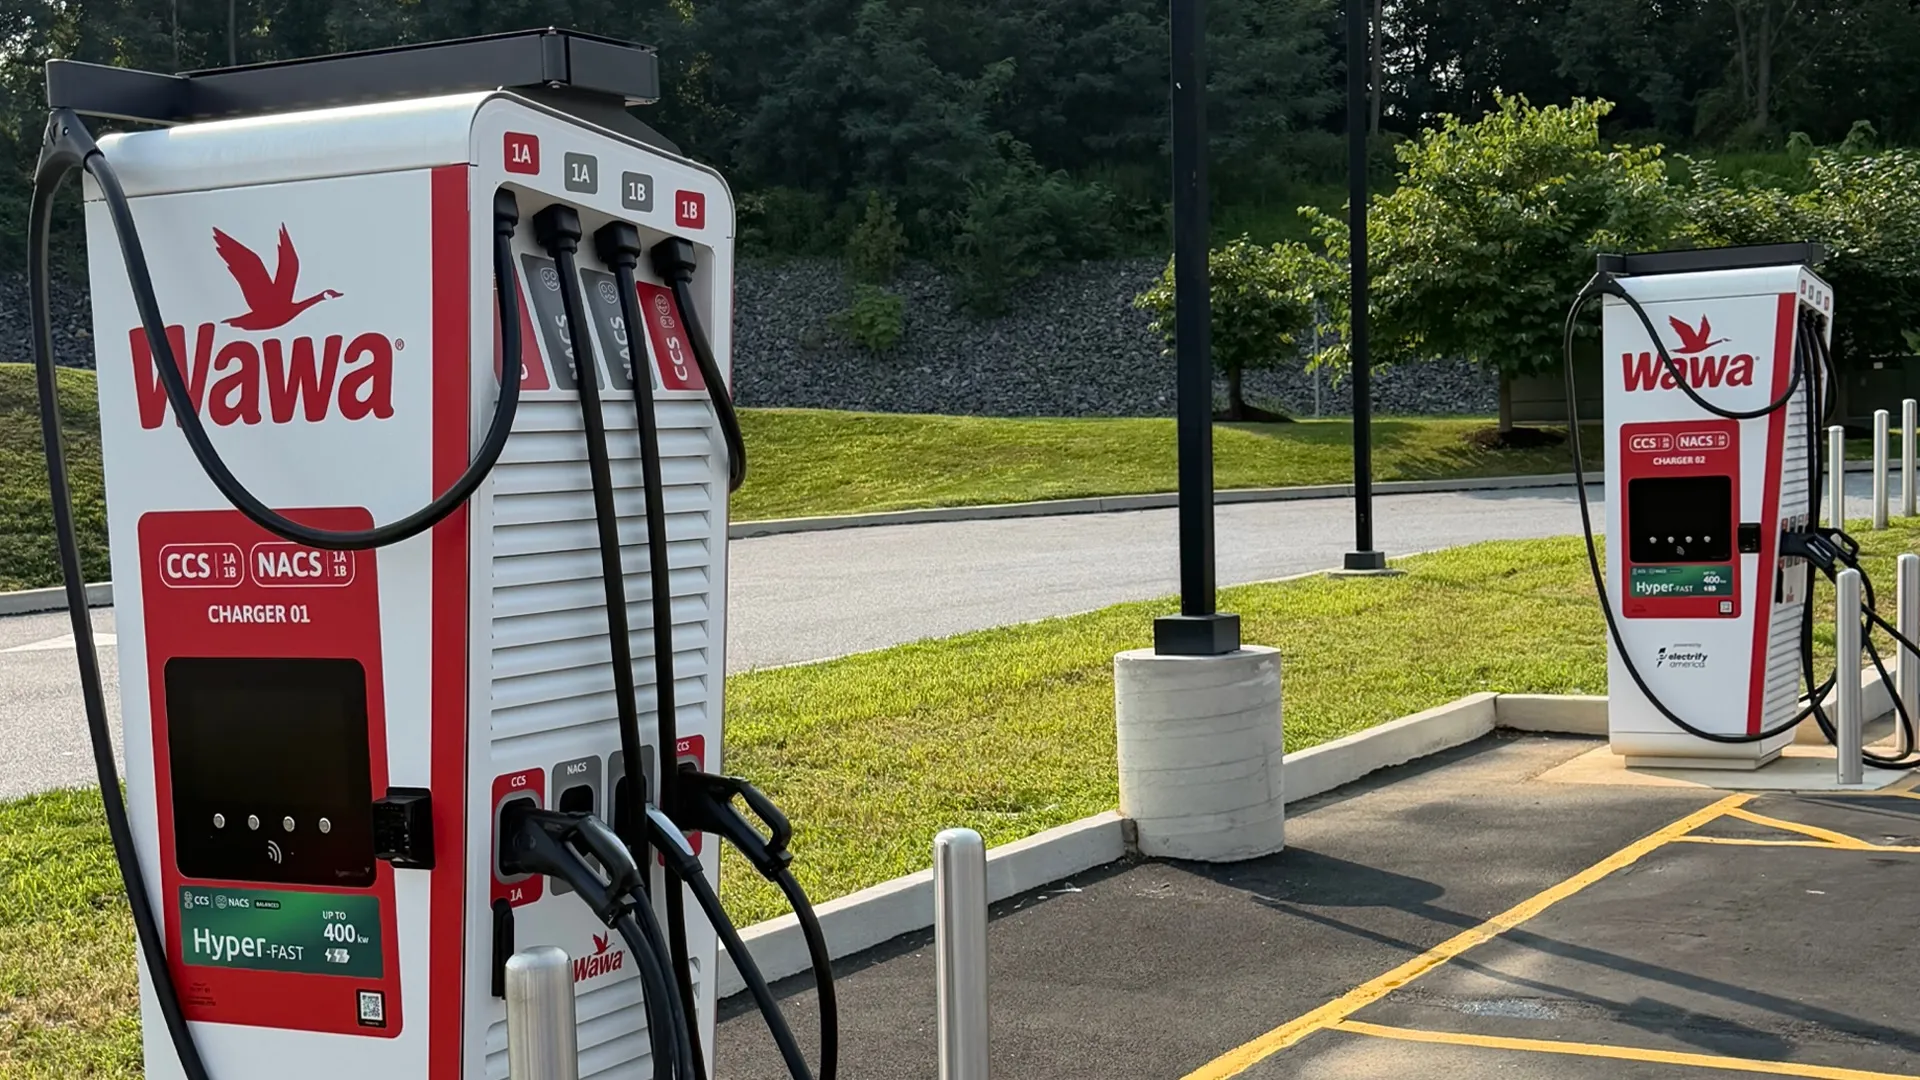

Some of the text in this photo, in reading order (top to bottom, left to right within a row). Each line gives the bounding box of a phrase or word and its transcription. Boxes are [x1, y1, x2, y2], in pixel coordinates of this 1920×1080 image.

[512, 143, 531, 164] 1A
[572, 163, 590, 184] 1A
[629, 182, 646, 201] 1B
[682, 201, 697, 219] 1B
[667, 336, 688, 381] CCS
[128, 322, 394, 430] Wawa
[1622, 352, 1755, 392] Wawa
[1633, 438, 1656, 449] CCS
[1680, 435, 1713, 448] NACS
[1653, 455, 1706, 466] CHARGER 02
[223, 553, 236, 565] 1A
[333, 551, 347, 563] 1A
[167, 553, 211, 579] CCS
[258, 551, 323, 578] NACS
[334, 565, 347, 577] 1B
[223, 566, 237, 578] 1B
[1703, 575, 1720, 584] 400
[208, 604, 311, 623] CHARGER 01
[567, 762, 587, 775] NACS
[511, 774, 526, 788] CCS
[194, 895, 209, 905] CCS
[510, 888, 523, 902] 1A
[228, 898, 249, 908] NACS
[322, 911, 346, 920] UP TO
[323, 923, 356, 943] 400
[573, 950, 623, 983] Wawa
